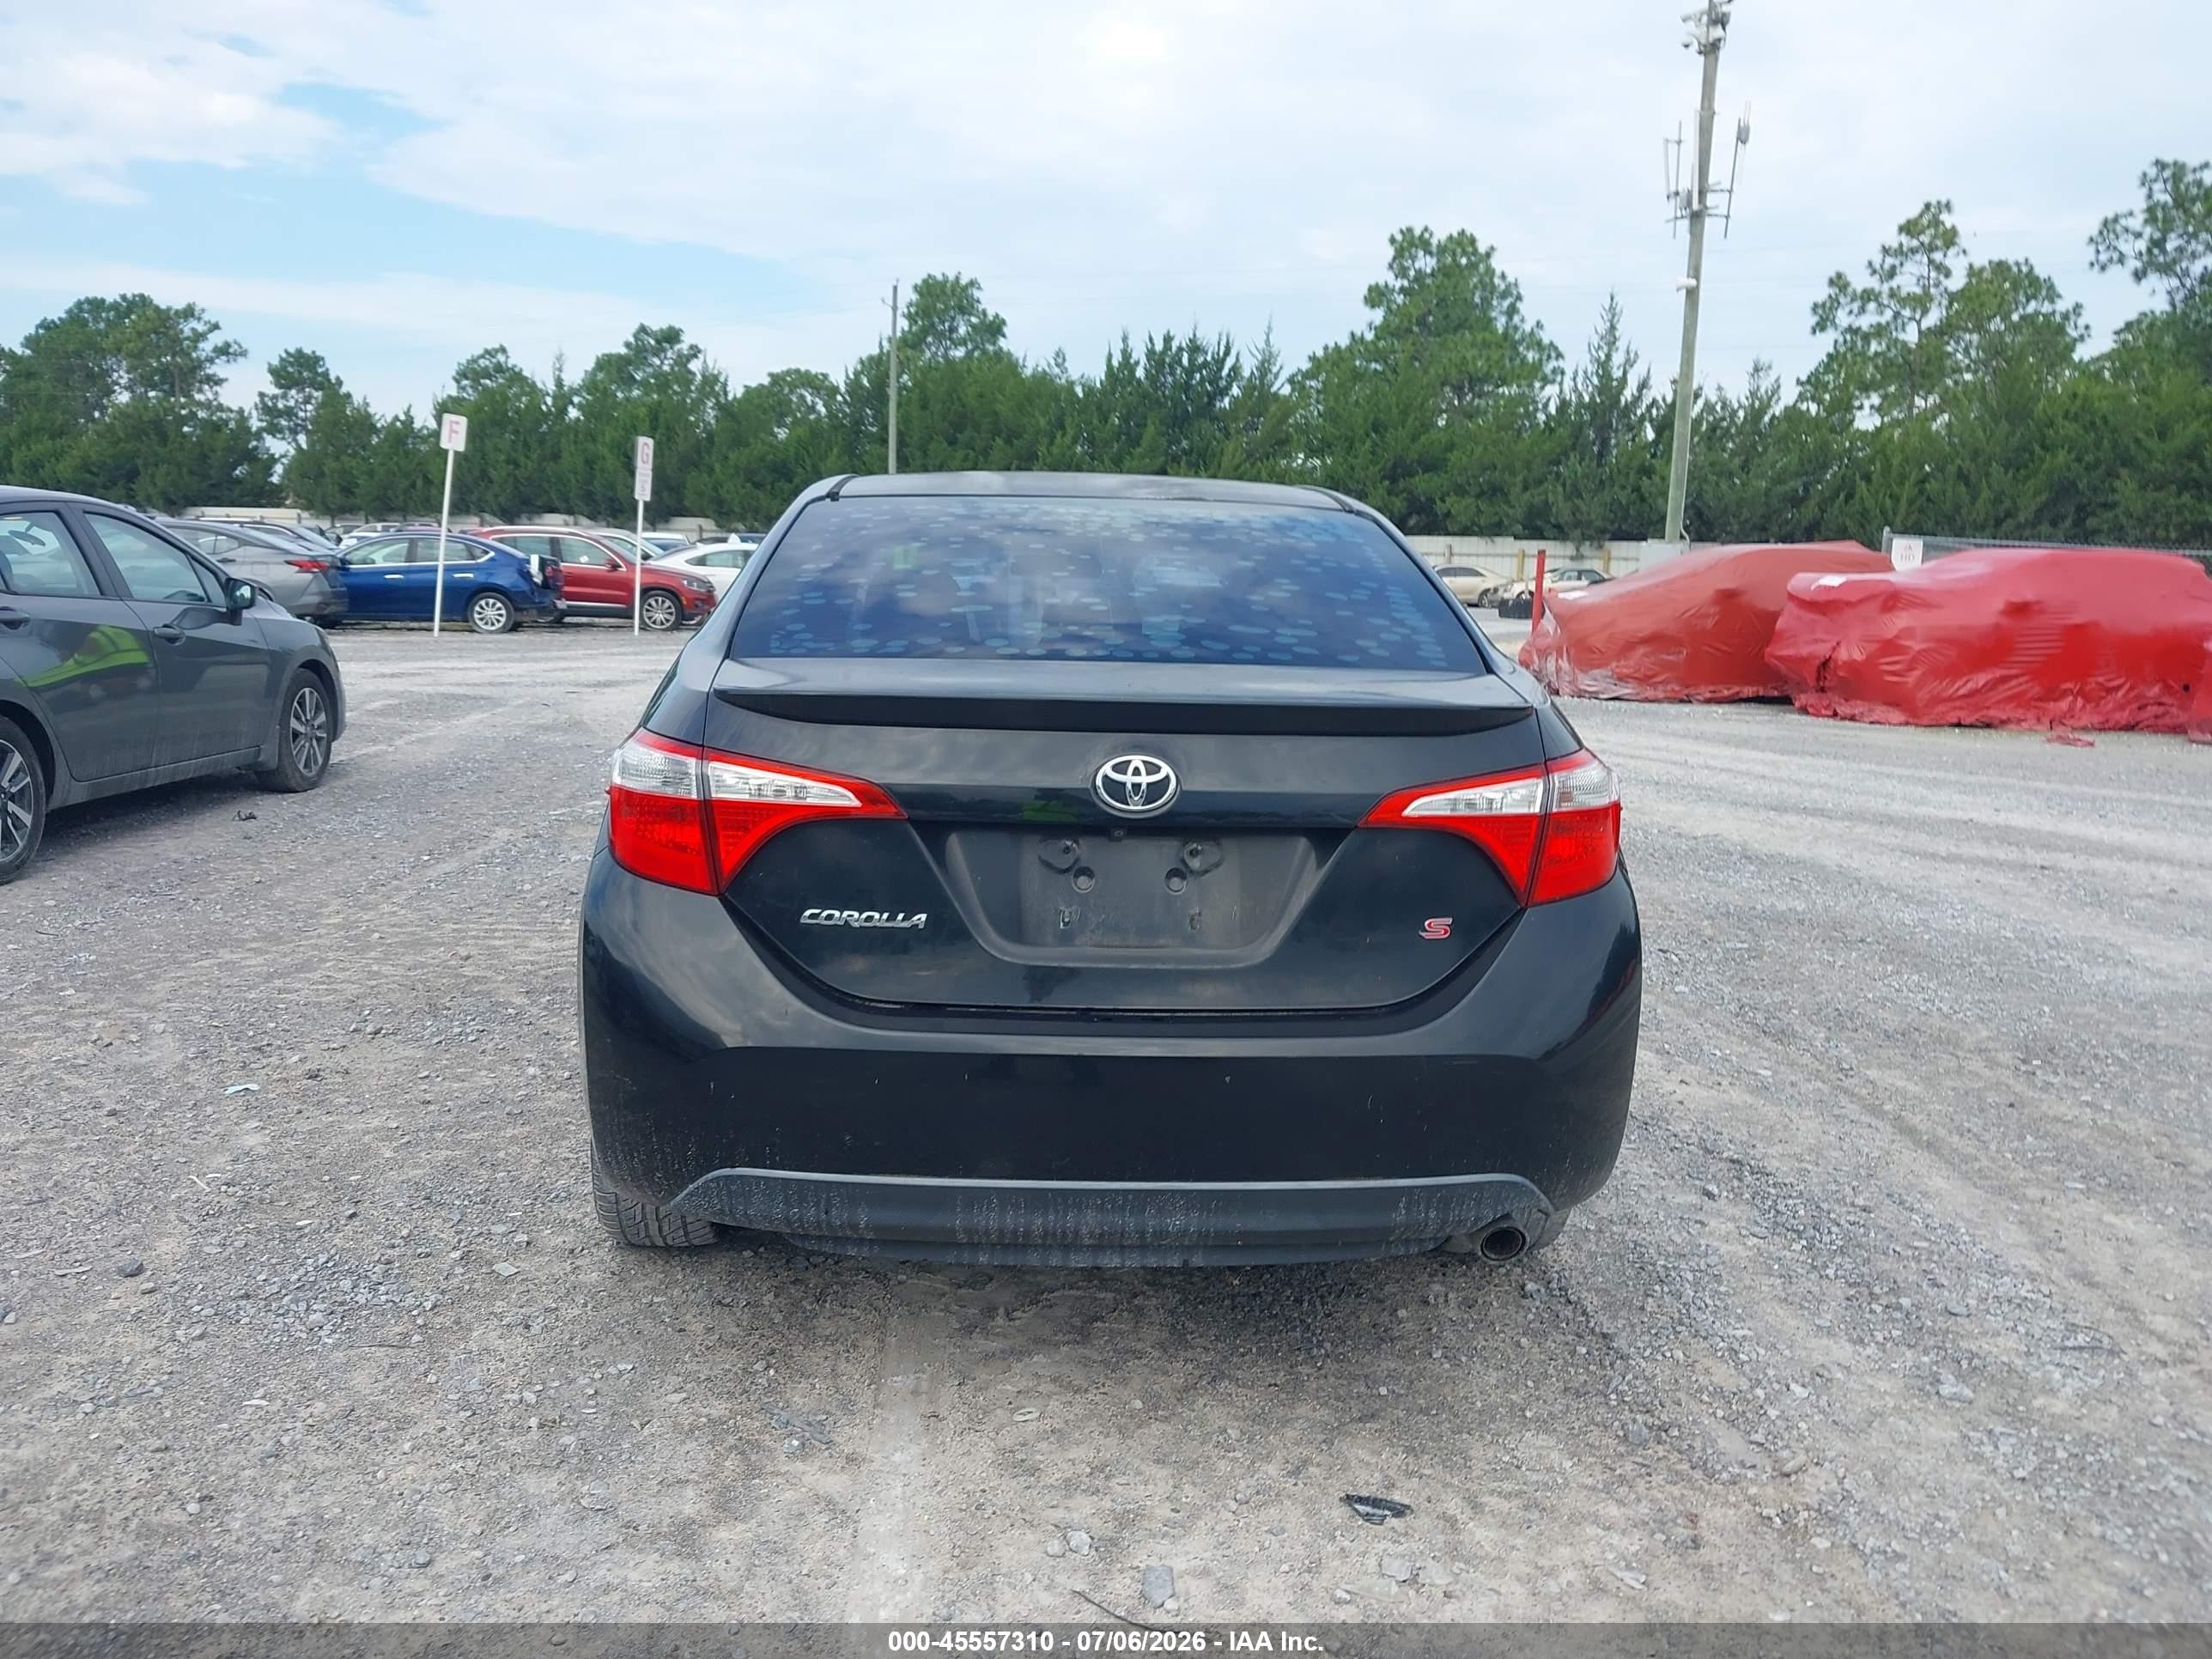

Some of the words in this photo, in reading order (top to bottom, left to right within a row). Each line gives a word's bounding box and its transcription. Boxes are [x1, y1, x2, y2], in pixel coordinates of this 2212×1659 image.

[447, 420, 460, 443] F
[641, 441, 650, 465] G
[799, 908, 927, 929] COROLLA
[1419, 917, 1453, 939] S
